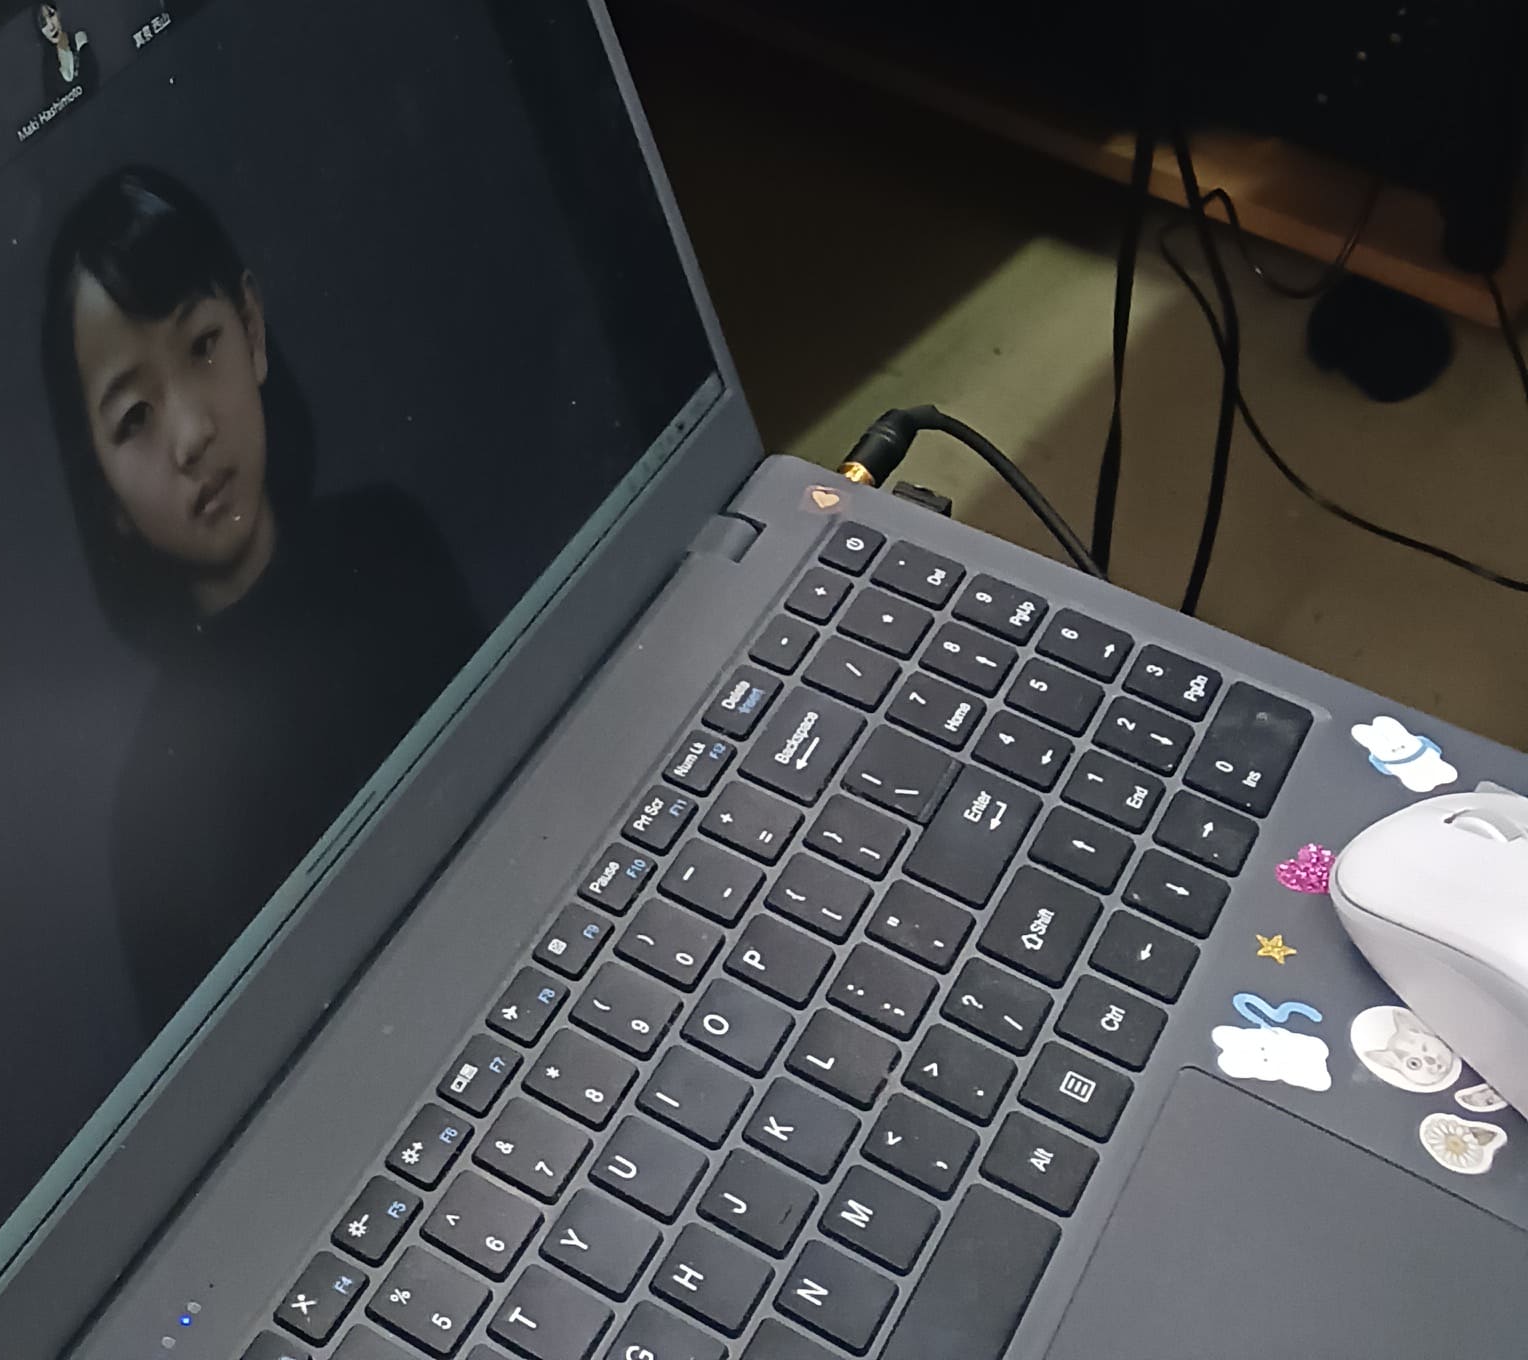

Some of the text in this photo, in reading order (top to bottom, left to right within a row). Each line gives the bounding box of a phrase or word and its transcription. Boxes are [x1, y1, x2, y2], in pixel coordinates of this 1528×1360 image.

[975, 591, 992, 604] 9
[1061, 627, 1079, 640] 6
[943, 641, 960, 653] 8
[1146, 664, 1164, 677] 3
[1029, 679, 1048, 692] 5
[909, 691, 926, 705] 7
[1117, 717, 1136, 731] 2
[998, 732, 1015, 744] 4
[1215, 760, 1234, 773] 0
[1087, 772, 1104, 783] 1
[675, 952, 694, 966] 0
[743, 949, 766, 970] P
[631, 1019, 650, 1034] 9
[703, 1013, 729, 1036] O
[806, 1054, 835, 1070] L
[585, 1088, 605, 1102] 8
[655, 1092, 680, 1108] I
[763, 1116, 794, 1141] K
[535, 1160, 554, 1177] 7
[607, 1155, 637, 1179] U
[723, 1192, 748, 1214] J
[840, 1199, 874, 1229] M
[486, 1236, 505, 1252] 6
[560, 1228, 589, 1250] Y
[672, 1264, 704, 1291] H
[795, 1278, 829, 1306] N
[432, 1312, 452, 1330] 5
[509, 1306, 537, 1329] T
